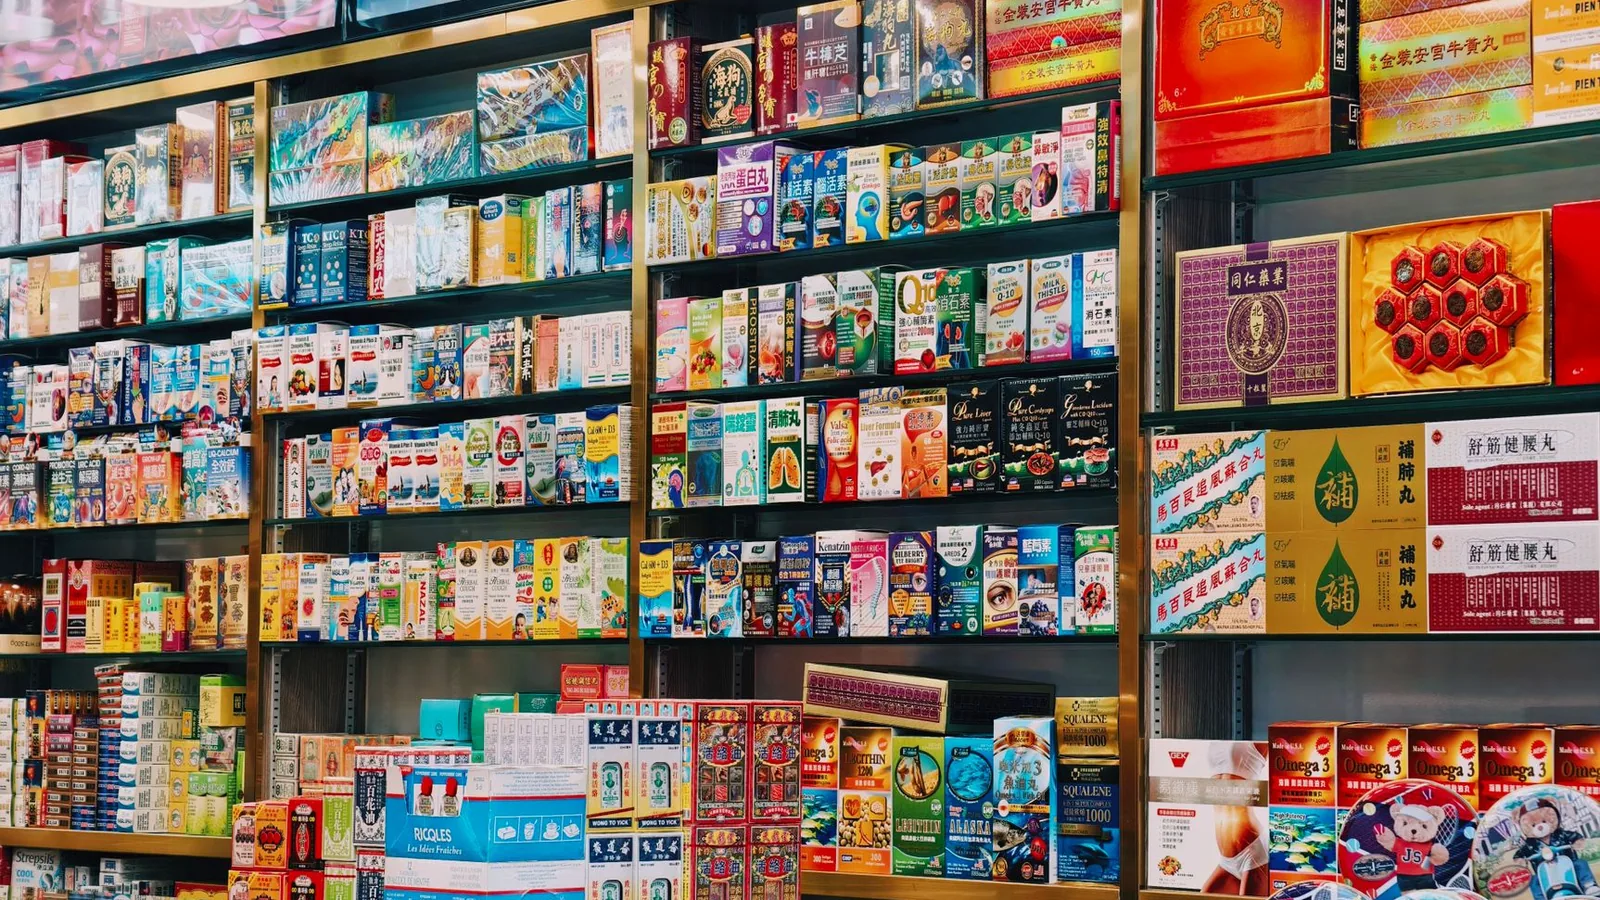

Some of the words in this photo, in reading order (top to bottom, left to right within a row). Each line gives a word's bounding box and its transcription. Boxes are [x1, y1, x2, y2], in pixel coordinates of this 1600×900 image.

[1575, 1, 1596, 14] PIEN
[1336, 0, 1346, 68] 北京安宮
[805, 43, 848, 66] 牛樟芝
[713, 63, 741, 90] 海狗
[1575, 77, 1596, 91] PIEN
[736, 166, 769, 188] 蛋白丸
[1042, 279, 1060, 290] MILK
[1231, 267, 1284, 289] 同仁藥業
[1038, 285, 1066, 300] THISTLE
[938, 293, 970, 311] 消石素
[1085, 309, 1113, 320] 消石素
[749, 298, 758, 373] PROSTRAL
[522, 328, 535, 381] 納豆素
[768, 409, 801, 430] 清肺丸
[975, 408, 992, 418] Liver
[1468, 433, 1556, 456] 舒筋健腰丸
[1397, 440, 1415, 505] 補肺丸
[1317, 471, 1354, 511] 補
[818, 541, 850, 552] Kenatzin
[961, 547, 967, 558] 2
[1469, 541, 1557, 563] 舒筋健腰丸
[1398, 545, 1416, 610] 補肺丸
[1318, 574, 1354, 614] 補
[1064, 714, 1107, 724] SQUALENE
[1084, 735, 1107, 747] 1000
[829, 745, 835, 758] 3
[857, 765, 873, 777] 1200
[1275, 756, 1320, 776] Omega
[1322, 757, 1330, 772] 3
[1344, 758, 1391, 779] Omega
[1394, 759, 1401, 775] 3
[1416, 760, 1464, 781] Omega
[1467, 761, 1475, 777] 3
[1486, 760, 1534, 782] Omega
[1539, 761, 1547, 777] 3
[1063, 785, 1112, 797] SQUALENE
[365, 786, 376, 824] 百花油
[1086, 809, 1111, 822] 1000
[414, 827, 452, 842] RICQLES
[896, 818, 942, 834] LECITHIN
[949, 820, 991, 834] ALASKA
[15, 851, 55, 866] Strepsils
[16, 869, 35, 878] COOL
